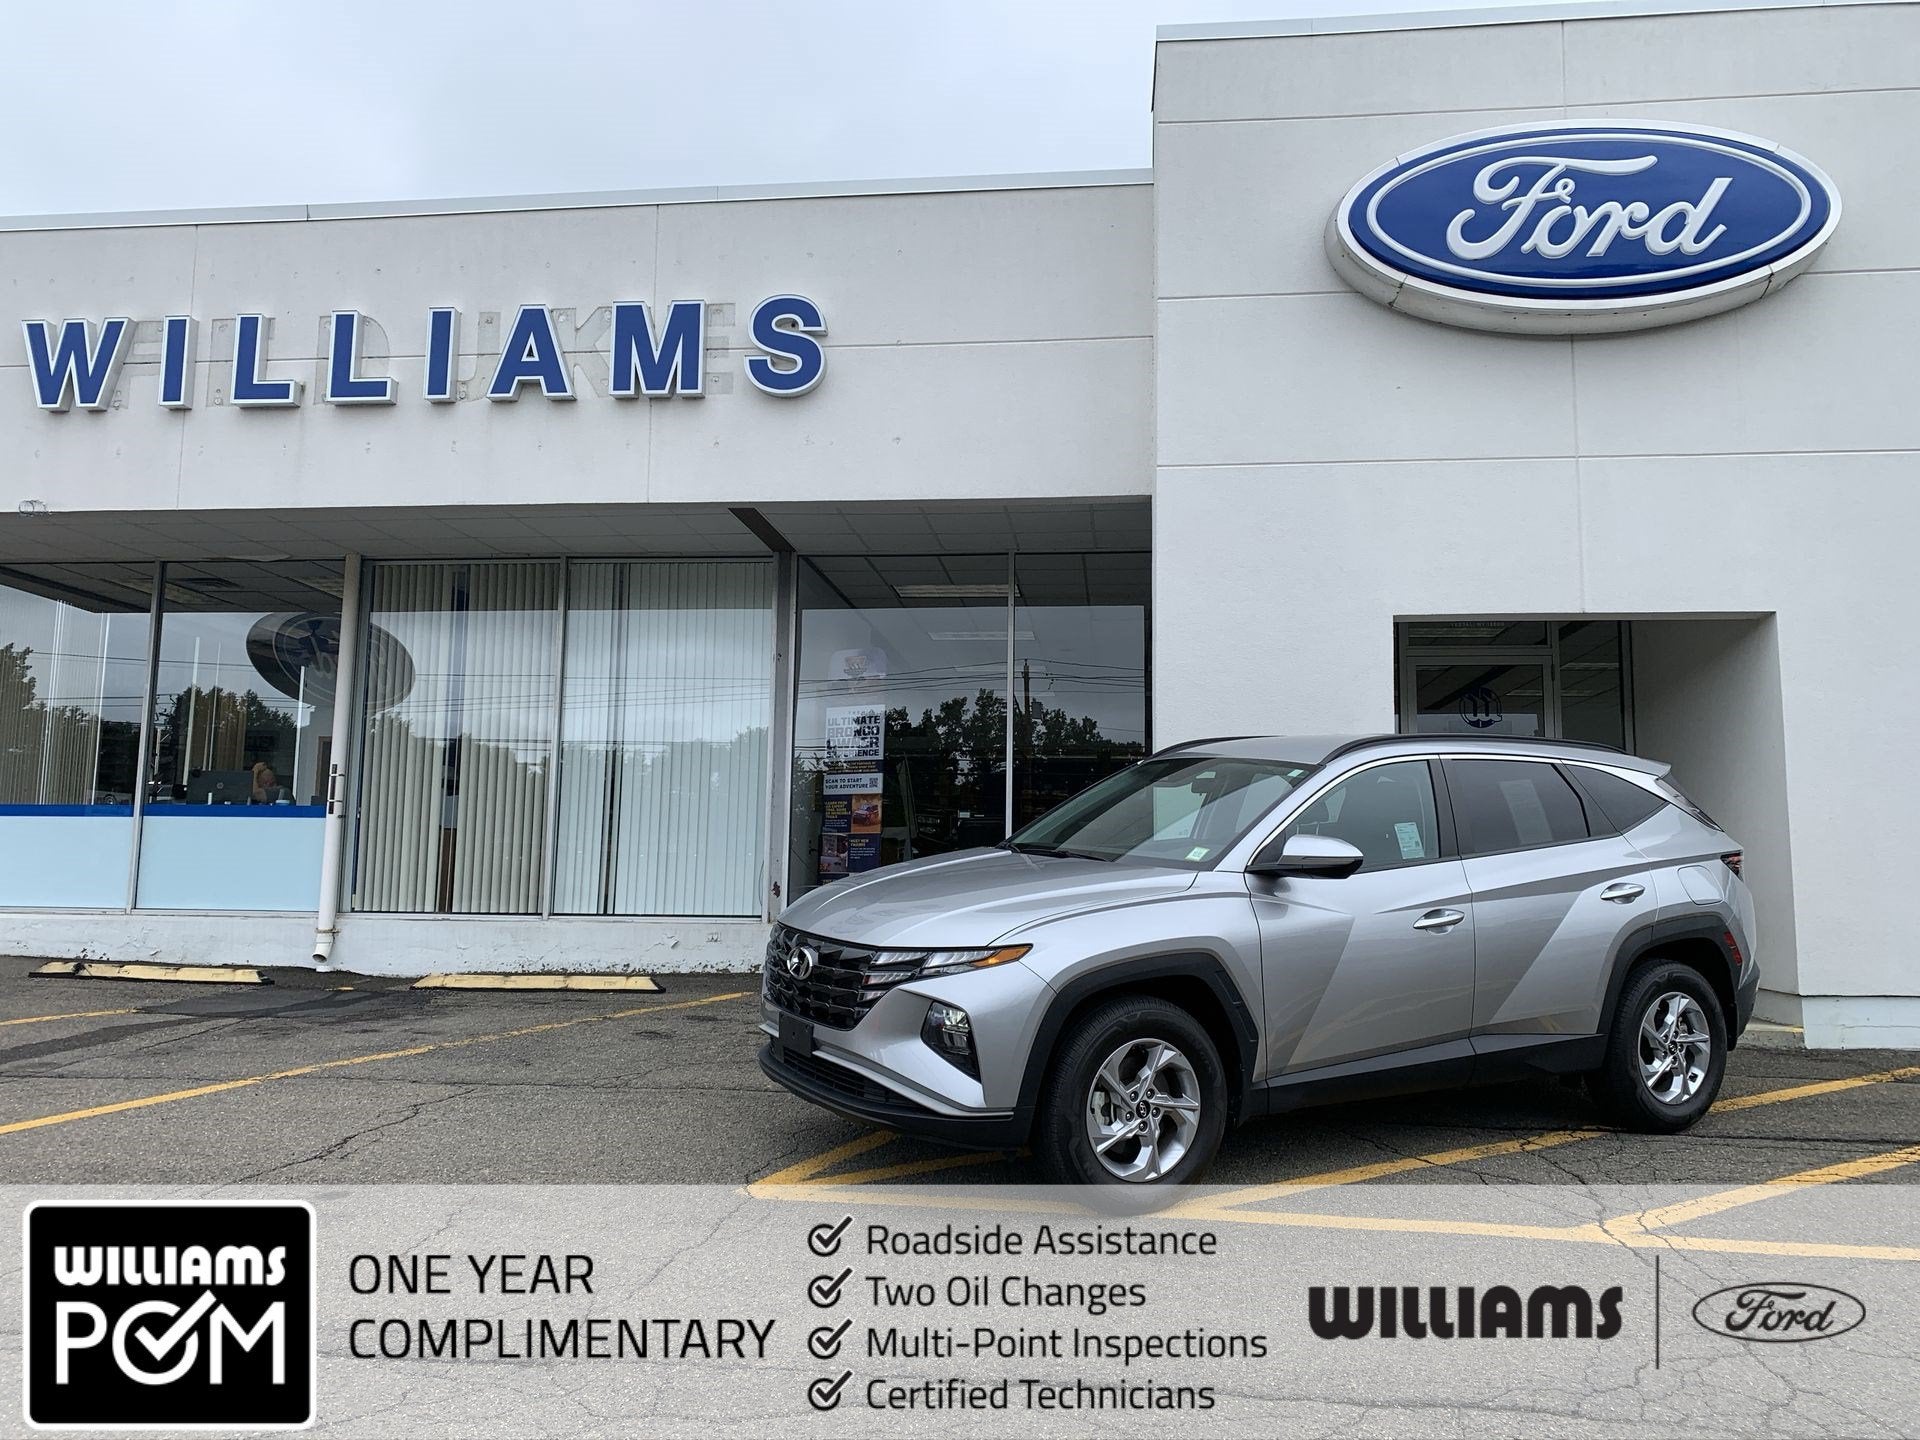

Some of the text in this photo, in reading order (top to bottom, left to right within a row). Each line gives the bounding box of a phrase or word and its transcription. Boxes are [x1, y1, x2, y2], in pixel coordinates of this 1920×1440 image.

[1446, 154, 1733, 261] Ford
[21, 294, 828, 411] WILLIAMS
[827, 715, 881, 727] ULTIMATE
